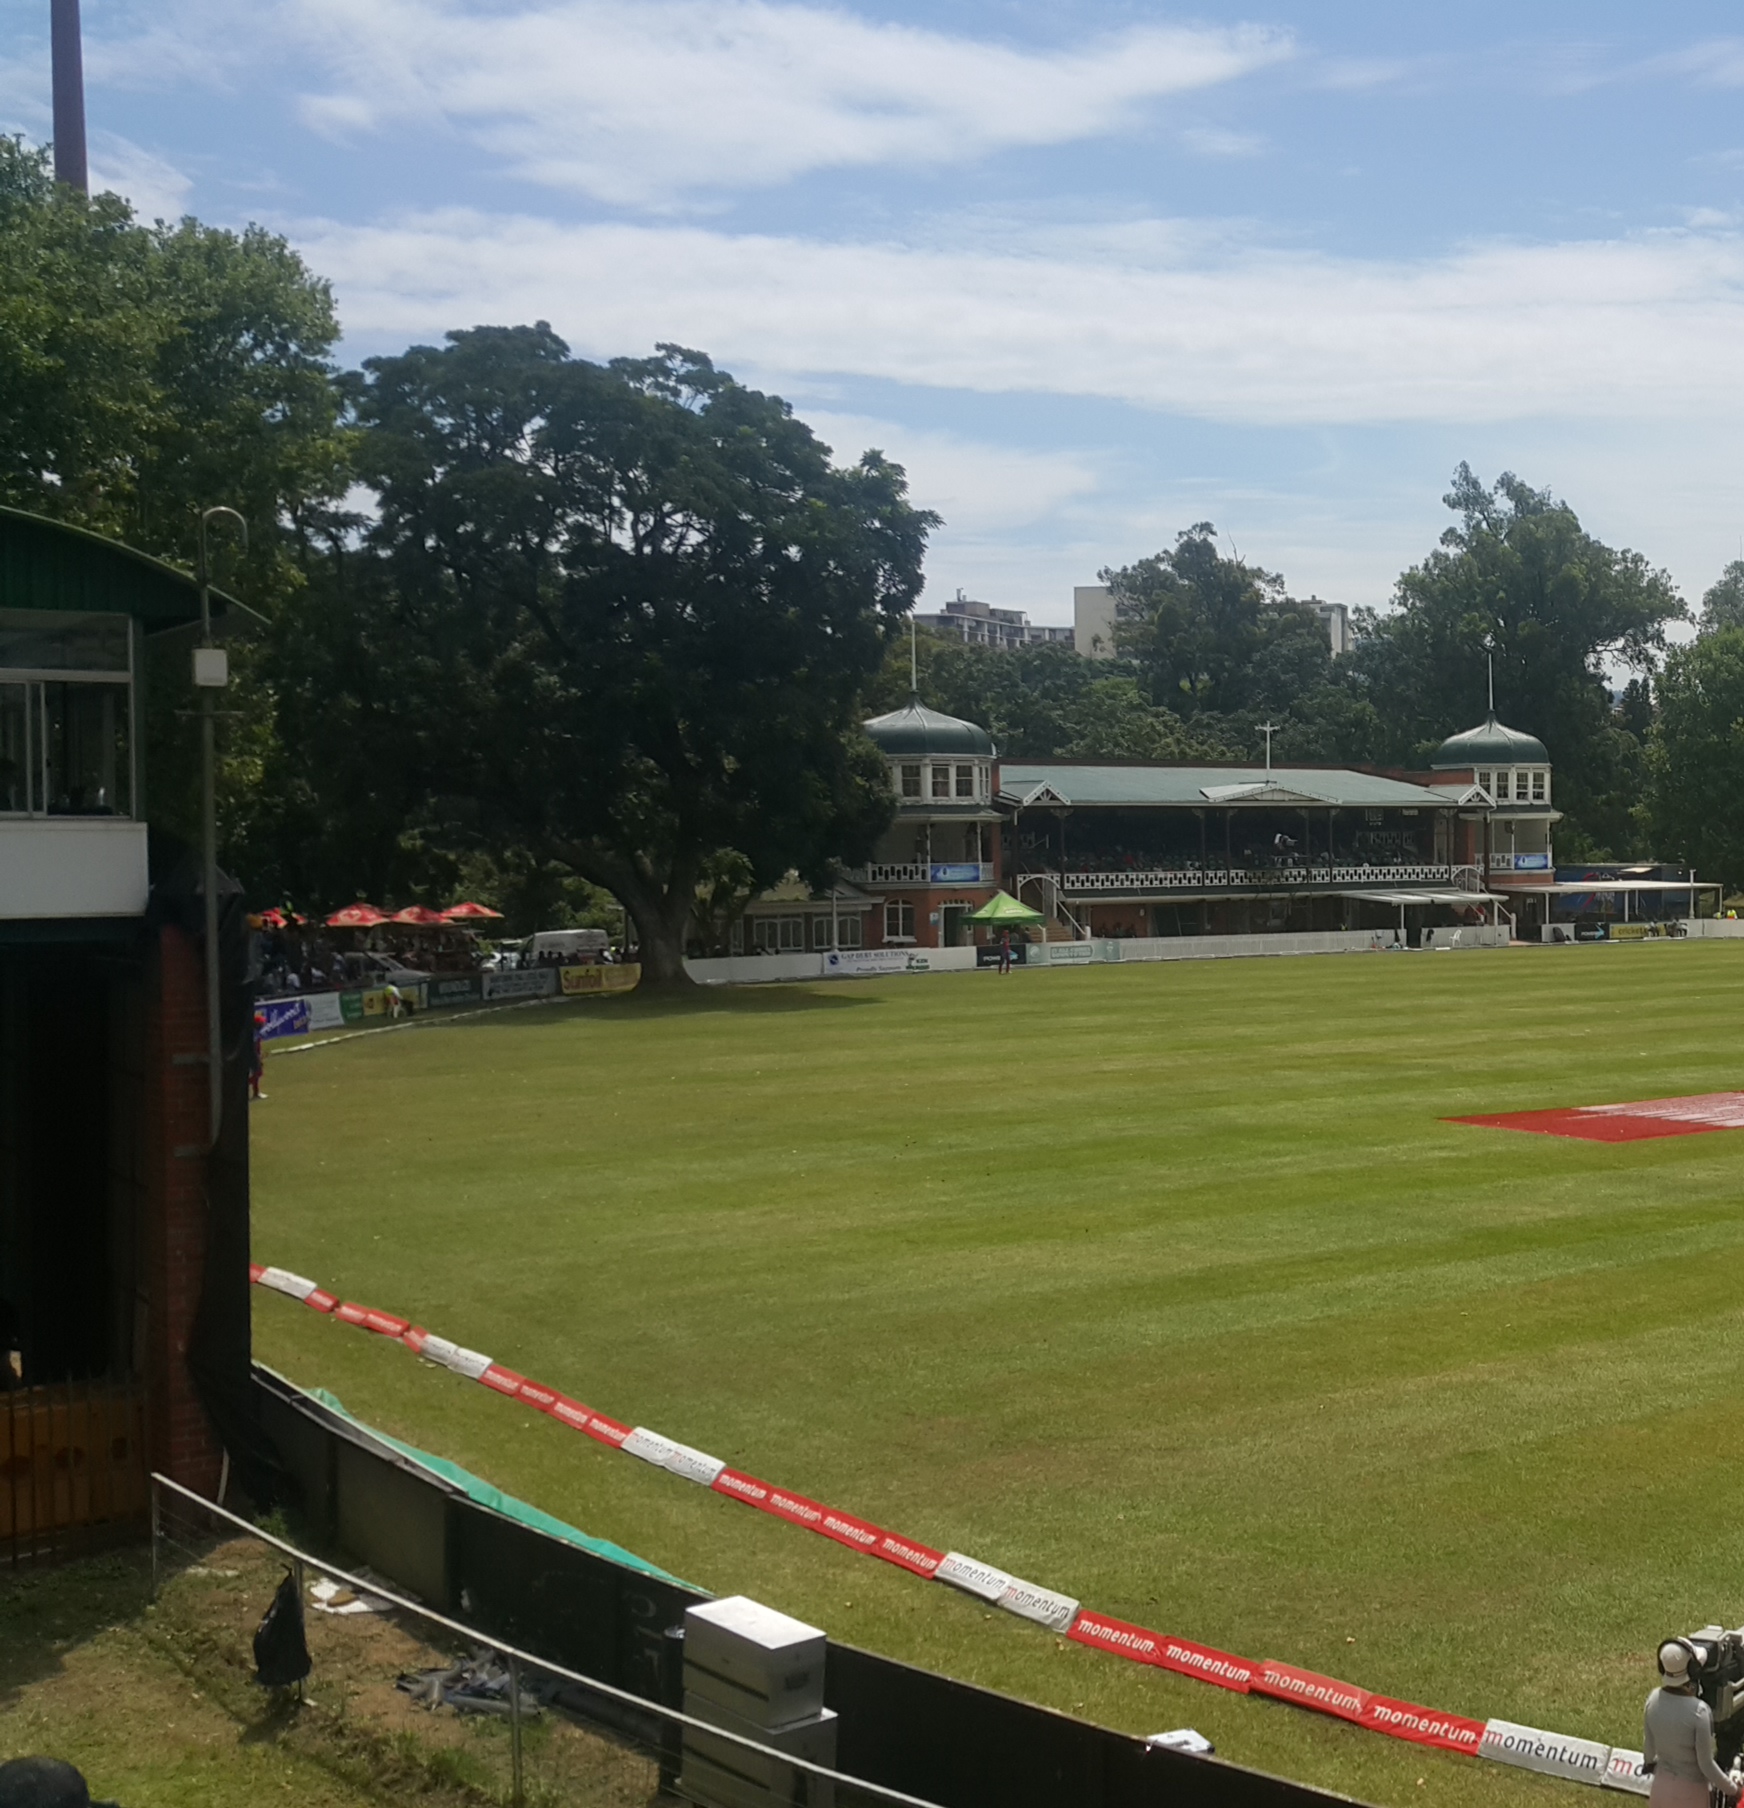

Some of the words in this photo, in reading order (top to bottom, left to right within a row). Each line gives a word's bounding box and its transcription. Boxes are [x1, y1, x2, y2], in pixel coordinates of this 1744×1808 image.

[718, 1474, 768, 1499] momentum
[770, 1493, 819, 1521] momentum
[823, 1515, 876, 1546] momentum
[882, 1537, 938, 1571] momentum
[944, 1556, 1006, 1589] momentum
[1004, 1584, 1071, 1619] momentum
[1077, 1618, 1155, 1653] momentum
[1166, 1643, 1251, 1683] momentum
[1263, 1669, 1360, 1712] momentum
[1373, 1703, 1478, 1745] momentum
[1484, 1727, 1599, 1771] momentum
